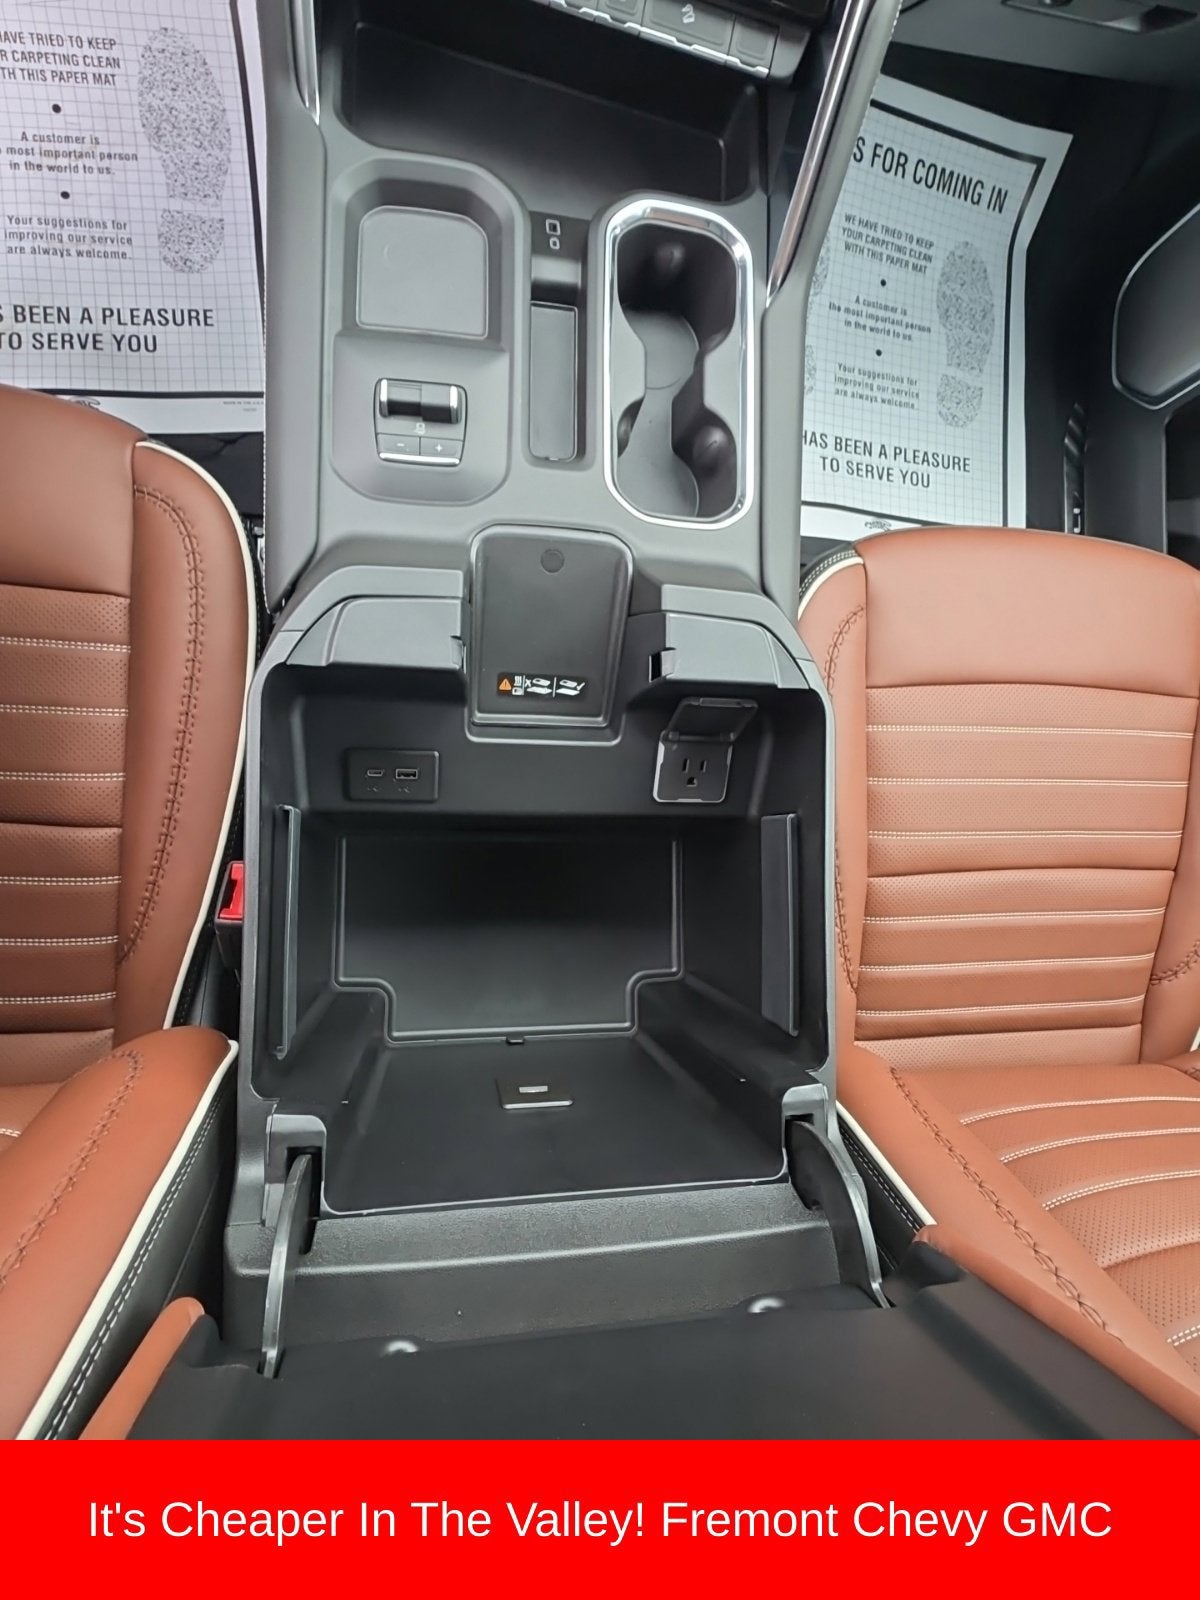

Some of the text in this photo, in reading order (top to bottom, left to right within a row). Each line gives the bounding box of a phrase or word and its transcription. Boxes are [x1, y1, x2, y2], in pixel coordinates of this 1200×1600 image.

[0, 31, 117, 51] AVE TRIED TO KEEP
[11, 50, 80, 66] CARPETING
[83, 54, 121, 70] CLEAN
[19, 68, 48, 82] THIS
[51, 70, 90, 85] PAPER
[92, 73, 117, 86] MAT
[20, 131, 101, 145] A customer is
[6, 146, 35, 156] most
[39, 147, 96, 160] important
[99, 151, 139, 162] person
[9, 160, 20, 171] in
[24, 161, 43, 172] the
[46, 163, 80, 174] world
[83, 164, 94, 175] to
[870, 142, 909, 179] FOR
[912, 158, 985, 206] COMING
[987, 184, 1009, 214] IN
[7, 215, 128, 231] Your suggestions for
[844, 213, 935, 250] WE HAVE TRIED TO KEEP
[4, 228, 133, 246] improving our service
[842, 226, 933, 263] YOUR CARPETING CLEAN
[7, 245, 26, 255] are
[30, 245, 72, 259] always
[844, 241, 928, 275] WITH THIS PAPER MAT
[13, 304, 71, 325] BEEN
[79, 307, 94, 325] A
[101, 307, 215, 327] PLEASURE
[862, 299, 898, 314] customer
[828, 301, 932, 334] the most important person
[854, 320, 867, 331] the
[869, 325, 891, 337] world
[31, 332, 105, 351] SERVE
[112, 333, 159, 353] YOU
[837, 362, 918, 387] Your suggestions for
[834, 374, 874, 392] improving
[891, 387, 920, 400] service
[850, 390, 878, 404] always
[834, 435, 873, 457] BEEN
[878, 444, 888, 460] A
[893, 446, 971, 473] PLEASURE
[819, 456, 931, 488] TO SERVE YOU
